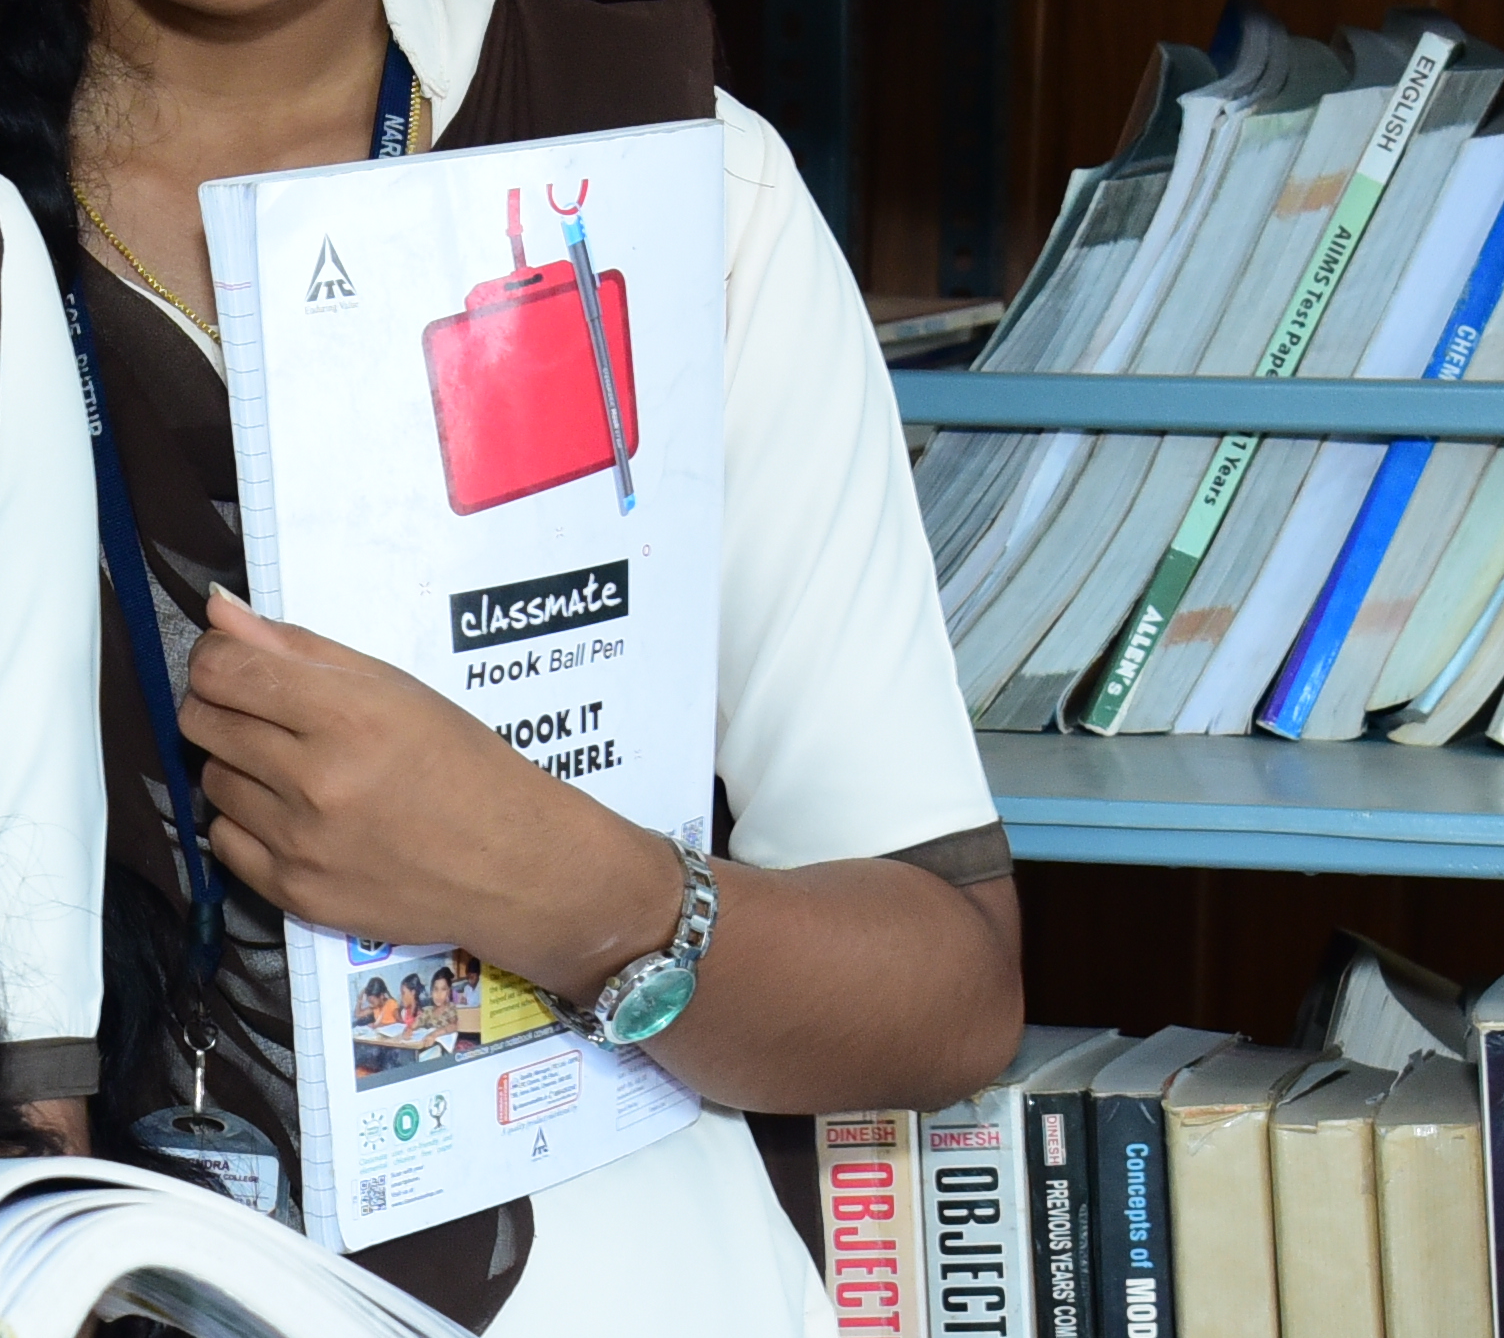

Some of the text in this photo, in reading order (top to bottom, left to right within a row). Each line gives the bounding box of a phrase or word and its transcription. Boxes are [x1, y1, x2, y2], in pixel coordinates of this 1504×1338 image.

[1375, 55, 1438, 153] ENGLISH
[1290, 224, 1352, 337] AIIMS Test
[1201, 456, 1242, 509] Years
[466, 636, 625, 690] Hook Ball Pen
[580, 701, 604, 734] IT
[930, 1132, 1000, 1147] DINESH
[1046, 1179, 1072, 1251] PREVIOUS
[1125, 1143, 1151, 1242] Concepts
[1051, 1253, 1074, 1301] YEARS'
[1130, 1248, 1150, 1268] of
